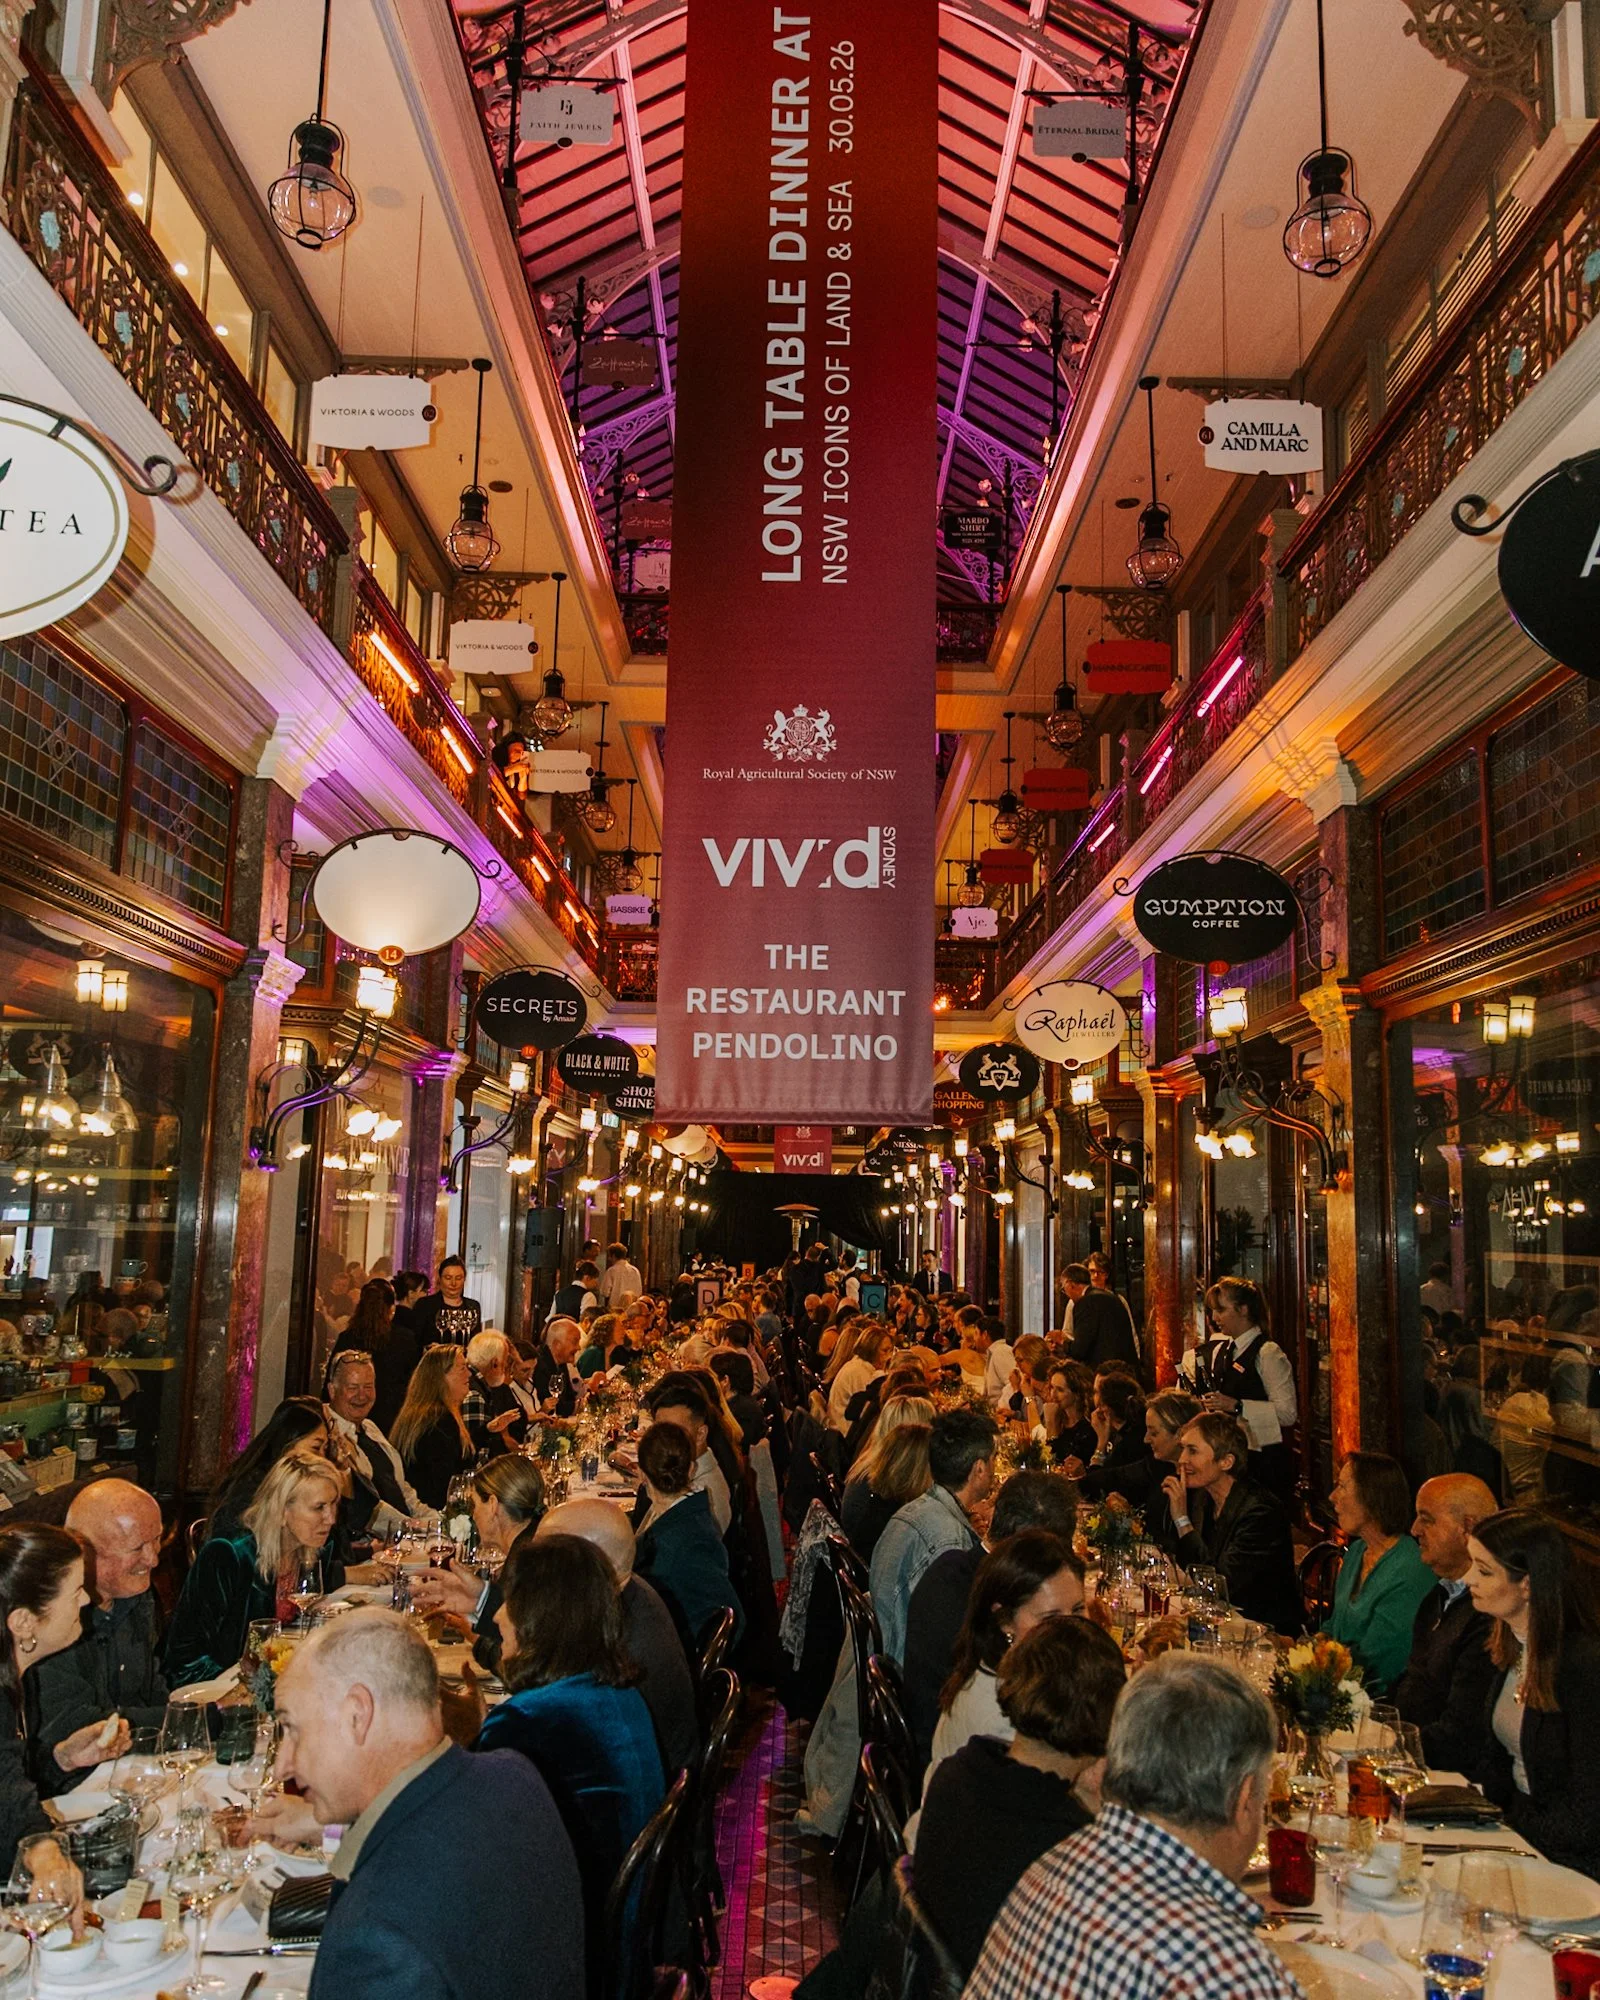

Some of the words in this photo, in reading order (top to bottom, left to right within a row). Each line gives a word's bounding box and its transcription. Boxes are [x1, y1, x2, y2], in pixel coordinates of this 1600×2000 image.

[772, 6, 811, 62] AT
[829, 40, 855, 154] 30.05.26
[1038, 126, 1082, 135] ETERNAL
[1085, 126, 1120, 136] BRIDAL
[768, 76, 810, 262] DINNER
[827, 180, 853, 232] SEA
[827, 242, 852, 261] &
[826, 271, 851, 346] LAND
[765, 279, 807, 429] TABLE
[825, 356, 851, 395] OF
[320, 408, 368, 416] VIKTORIA
[370, 408, 375, 416] &
[378, 408, 415, 416] WOODS
[1227, 421, 1301, 436] CAMILLA
[823, 405, 850, 503] ICONS
[1220, 437, 1257, 451] AND
[1260, 438, 1309, 452] MARC
[761, 447, 804, 582] LONG
[822, 513, 849, 584] NSW
[703, 767, 734, 782] Royal
[737, 767, 804, 782] Agricultural
[807, 768, 848, 783] Society
[851, 769, 865, 780] of
[866, 769, 897, 780] NSW
[882, 825, 896, 889] SYDNEY
[610, 905, 646, 914] BASSIKE
[1143, 899, 1286, 916] GUMPTION
[1192, 920, 1240, 928] COFFEE
[385, 949, 397, 960] 14
[764, 943, 829, 971] THE
[486, 997, 578, 1015] SECRETS
[686, 987, 906, 1016] RESTAURANT
[542, 1014, 552, 1023] by
[1024, 1008, 1116, 1042] Raphaël
[693, 1032, 898, 1061] PENDOLINO
[565, 1053, 592, 1069] BLACK
[593, 1055, 602, 1070] &
[603, 1055, 631, 1072] WHITE
[703, 1289, 715, 1305] D
[867, 1293, 881, 1309] C
